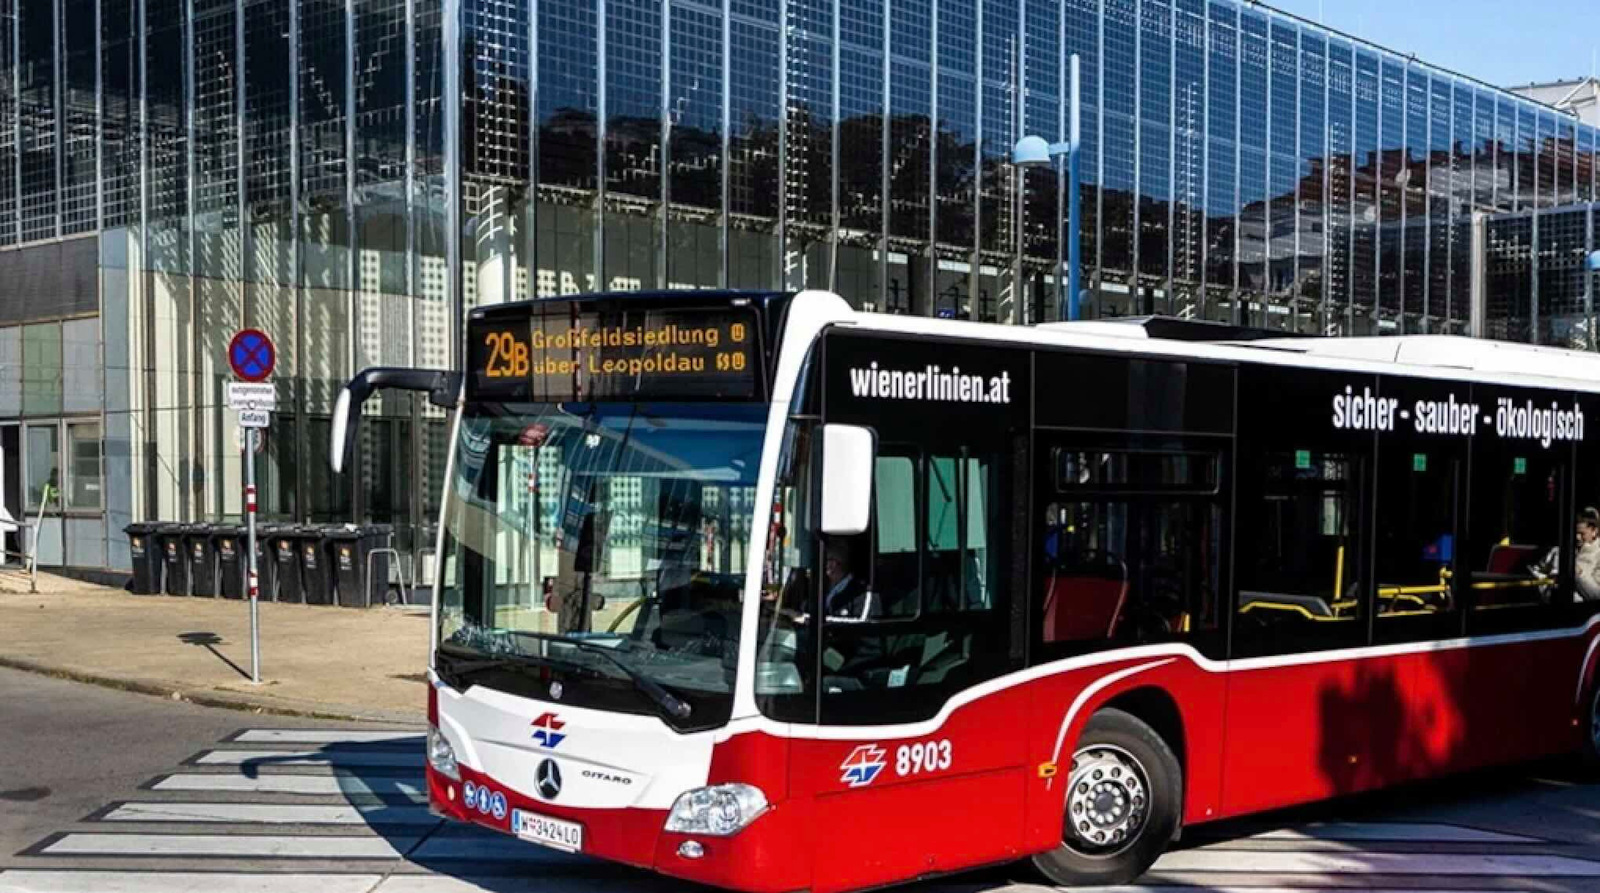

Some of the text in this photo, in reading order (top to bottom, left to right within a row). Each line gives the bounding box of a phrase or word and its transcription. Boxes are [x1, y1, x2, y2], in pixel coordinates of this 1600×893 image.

[532, 325, 719, 348] Großfeldsiedlung
[533, 359, 579, 375] über
[589, 353, 704, 376] Leopoldau
[850, 361, 1011, 404] wienerlinien.at
[241, 412, 266, 425] Anfang
[1332, 384, 1398, 431] sicher
[1414, 393, 1479, 435] sauber
[1496, 397, 1583, 449] ökologisch
[896, 739, 952, 776] 8903
